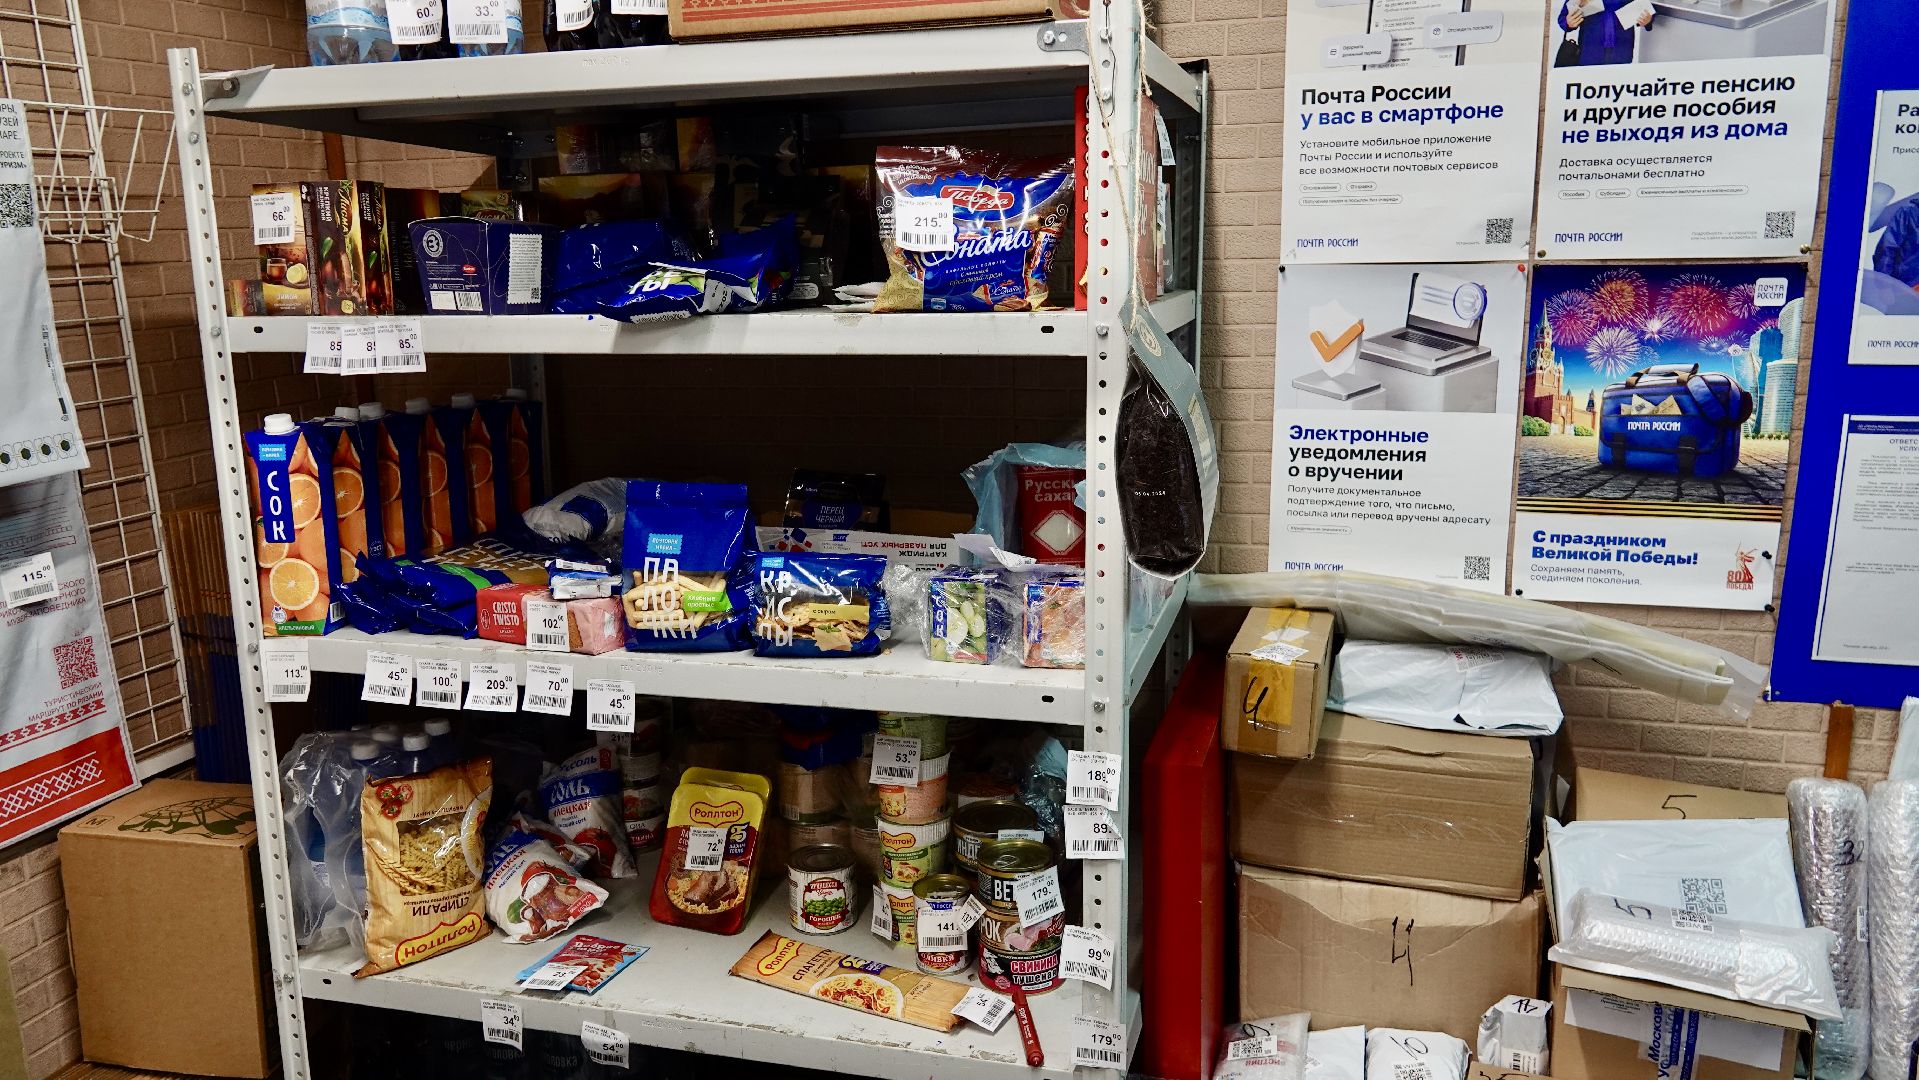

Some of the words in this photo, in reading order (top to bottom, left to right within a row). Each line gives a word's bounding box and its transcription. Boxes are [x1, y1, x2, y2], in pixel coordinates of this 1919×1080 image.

[1301, 88, 1365, 106] Почта
[1371, 84, 1452, 103] России
[1565, 78, 1695, 102] Получайте
[1701, 76, 1795, 94] пенсию
[1300, 112, 1313, 130] у
[1318, 109, 1355, 125] вас
[1361, 110, 1373, 124] в
[1379, 104, 1504, 126] смартфоне
[1563, 110, 1577, 122] и
[1583, 103, 1667, 125] другие
[1673, 97, 1776, 118] пособия
[1562, 130, 1590, 143] не
[1596, 126, 1684, 143] выходя
[1690, 124, 1719, 139] из
[1725, 122, 1788, 140] дома
[1895, 124, 1919, 134] ко
[1300, 138, 1359, 150] Установите
[1362, 136, 1421, 147] мобильное
[1423, 134, 1492, 146] приложение
[1300, 152, 1332, 162] Почты
[1335, 151, 1373, 161] России
[1375, 152, 1382, 160] и
[1384, 148, 1453, 161] используйте
[1559, 157, 1613, 168] Доставка
[1616, 154, 1712, 167] осуществляется
[1299, 166, 1317, 175] все
[1319, 164, 1390, 175] возможности
[1392, 163, 1444, 173] почтовых
[1446, 161, 1499, 172] сервисов
[1558, 169, 1640, 181] почтальонами
[1643, 168, 1705, 179] бесплатно
[1297, 238, 1325, 248] ПОЧТА
[1327, 238, 1359, 248] РОССИИ
[1555, 233, 1585, 243] ПОЧТА
[1588, 232, 1623, 242] РОССИИ
[1757, 284, 1785, 292] ПОЧТА
[1868, 340, 1892, 348] ПОЧТА
[1628, 421, 1650, 430] ПОЧТА
[1652, 421, 1681, 431] РОССИИ
[1289, 425, 1429, 444] Электронные
[1289, 446, 1427, 462] уведомления
[1288, 466, 1300, 477] о
[1305, 465, 1403, 482] вручении
[1287, 485, 1335, 495] Получите
[1336, 486, 1422, 497] документальное
[1287, 498, 1365, 508] подтверждение
[1367, 500, 1392, 509] того,
[1395, 501, 1412, 509] что
[1414, 502, 1456, 512] письмо,
[1287, 509, 1328, 519] посылка
[1330, 511, 1349, 519] или
[1351, 512, 1393, 522] перевод
[1396, 513, 1440, 524] вручены
[1442, 515, 1491, 526] адресату
[881, 541, 927, 550] ЛАЗЕРНЫХ
[1532, 530, 1546, 543] С
[1549, 531, 1667, 548] праздником
[898, 550, 947, 558] КАРТРИДЖ
[1531, 546, 1612, 562] Великой
[1616, 549, 1699, 567] Победы!
[1285, 561, 1311, 571] ПОЧТА
[1530, 564, 1585, 575] Сохраняем
[1587, 567, 1625, 577] память,
[1530, 574, 1584, 585] соединяем
[1586, 576, 1642, 586] поколения.
[492, 601, 517, 614] CRISTO
[492, 613, 520, 627] TWISTO
[44, 682, 102, 708] ТУРИСТИЧЕСКИЙ
[28, 704, 65, 722] МАРШРУТ
[77, 690, 104, 706] РЯЗАНИ
[1010, 954, 1058, 974] СВИНИНА
